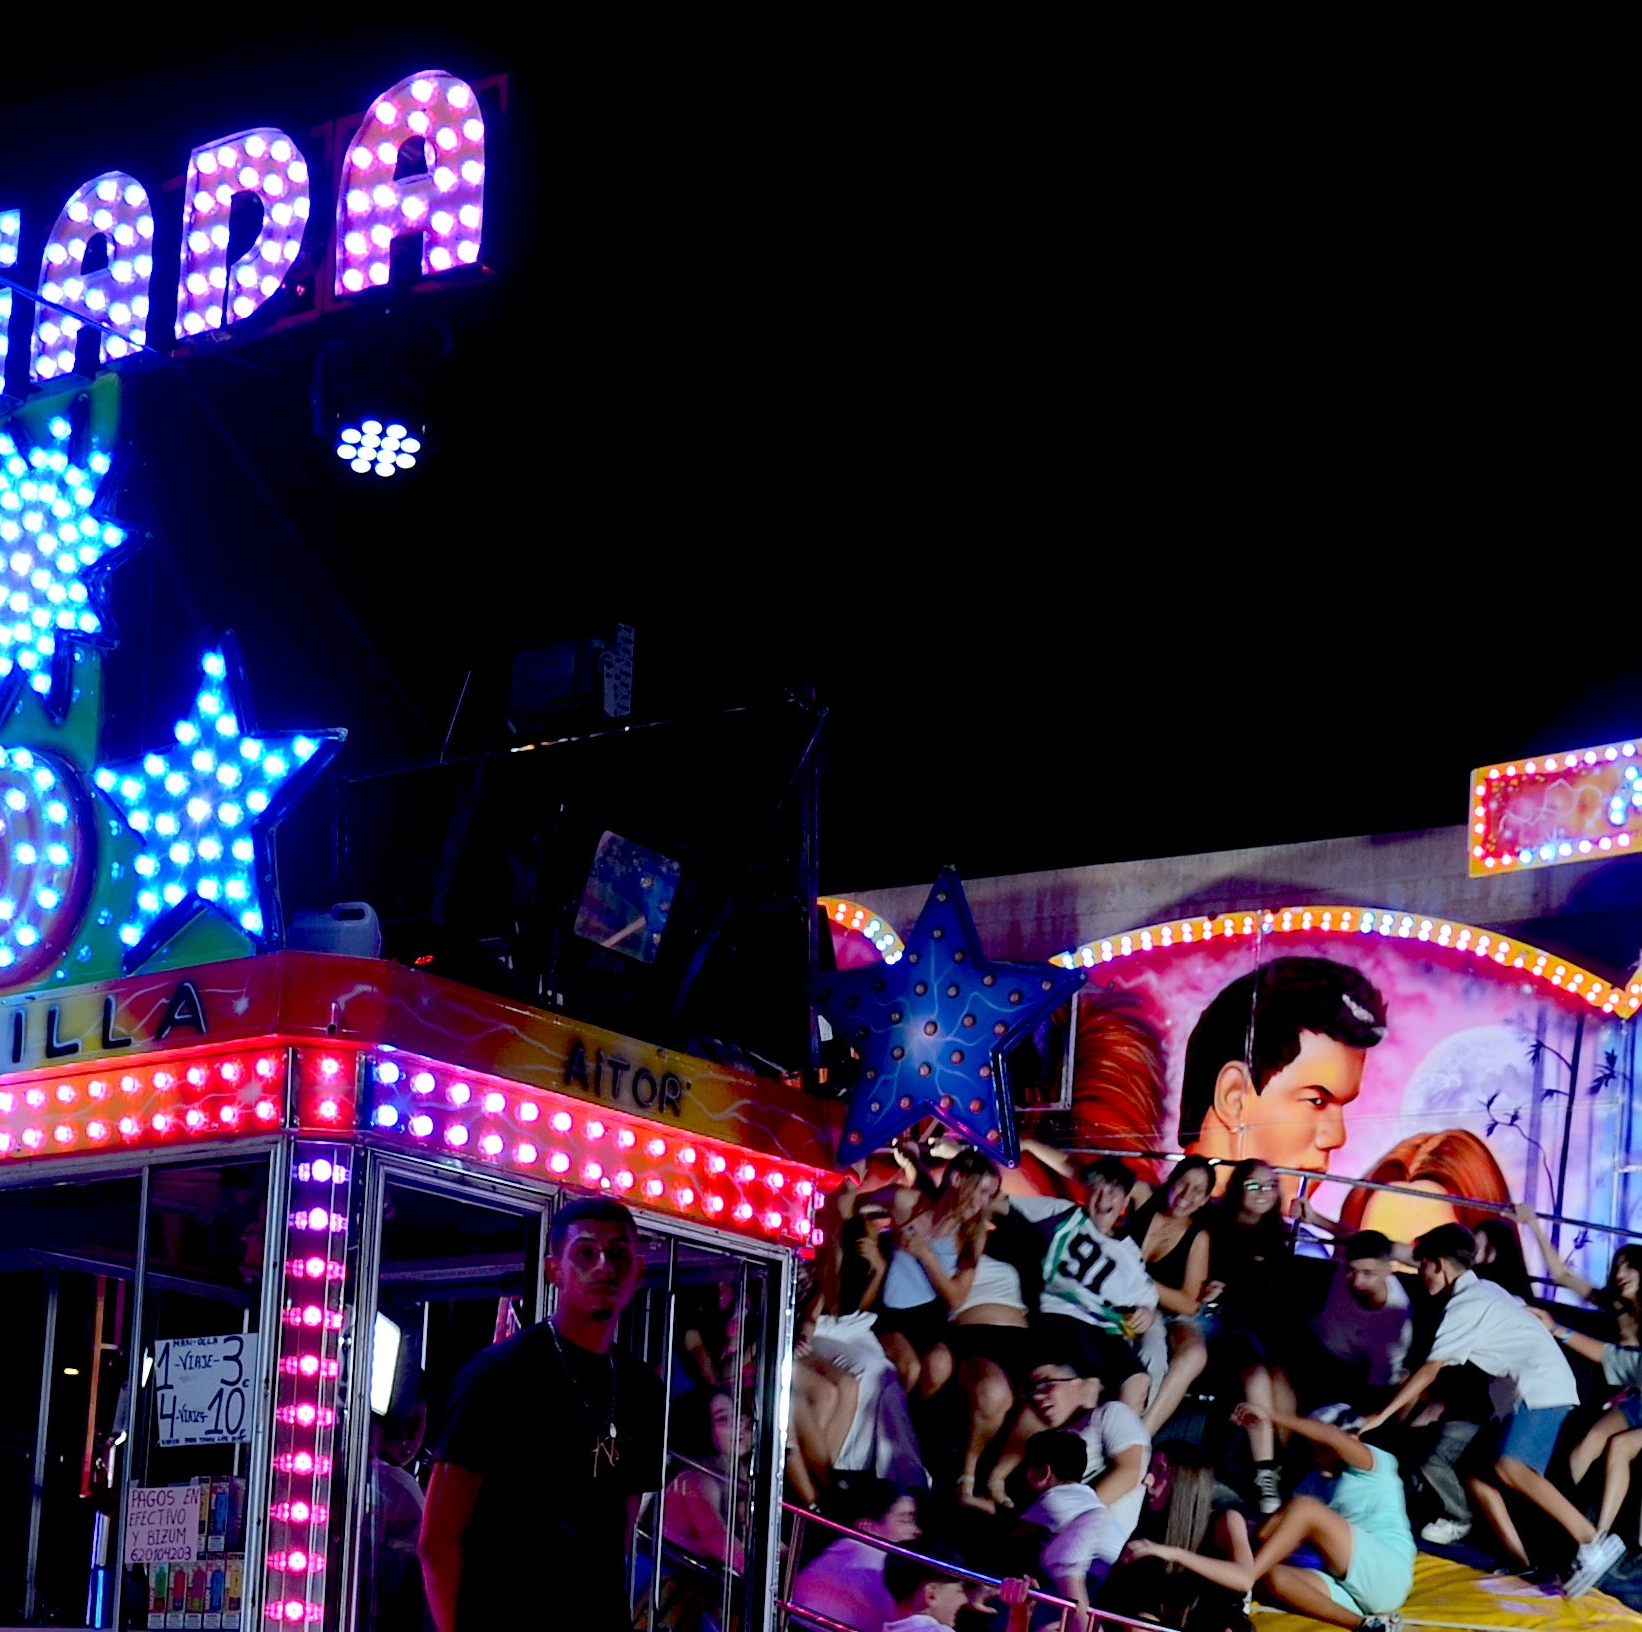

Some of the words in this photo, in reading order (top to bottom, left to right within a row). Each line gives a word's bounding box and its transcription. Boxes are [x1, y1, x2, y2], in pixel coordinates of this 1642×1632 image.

[1058, 1233, 1116, 1295] 91
[131, 1489, 175, 1508] PAGOS
[183, 1488, 199, 1505] EN
[128, 1508, 187, 1527] EFECTIVO
[132, 1531, 140, 1546] Y
[147, 1527, 187, 1546] BIZUM
